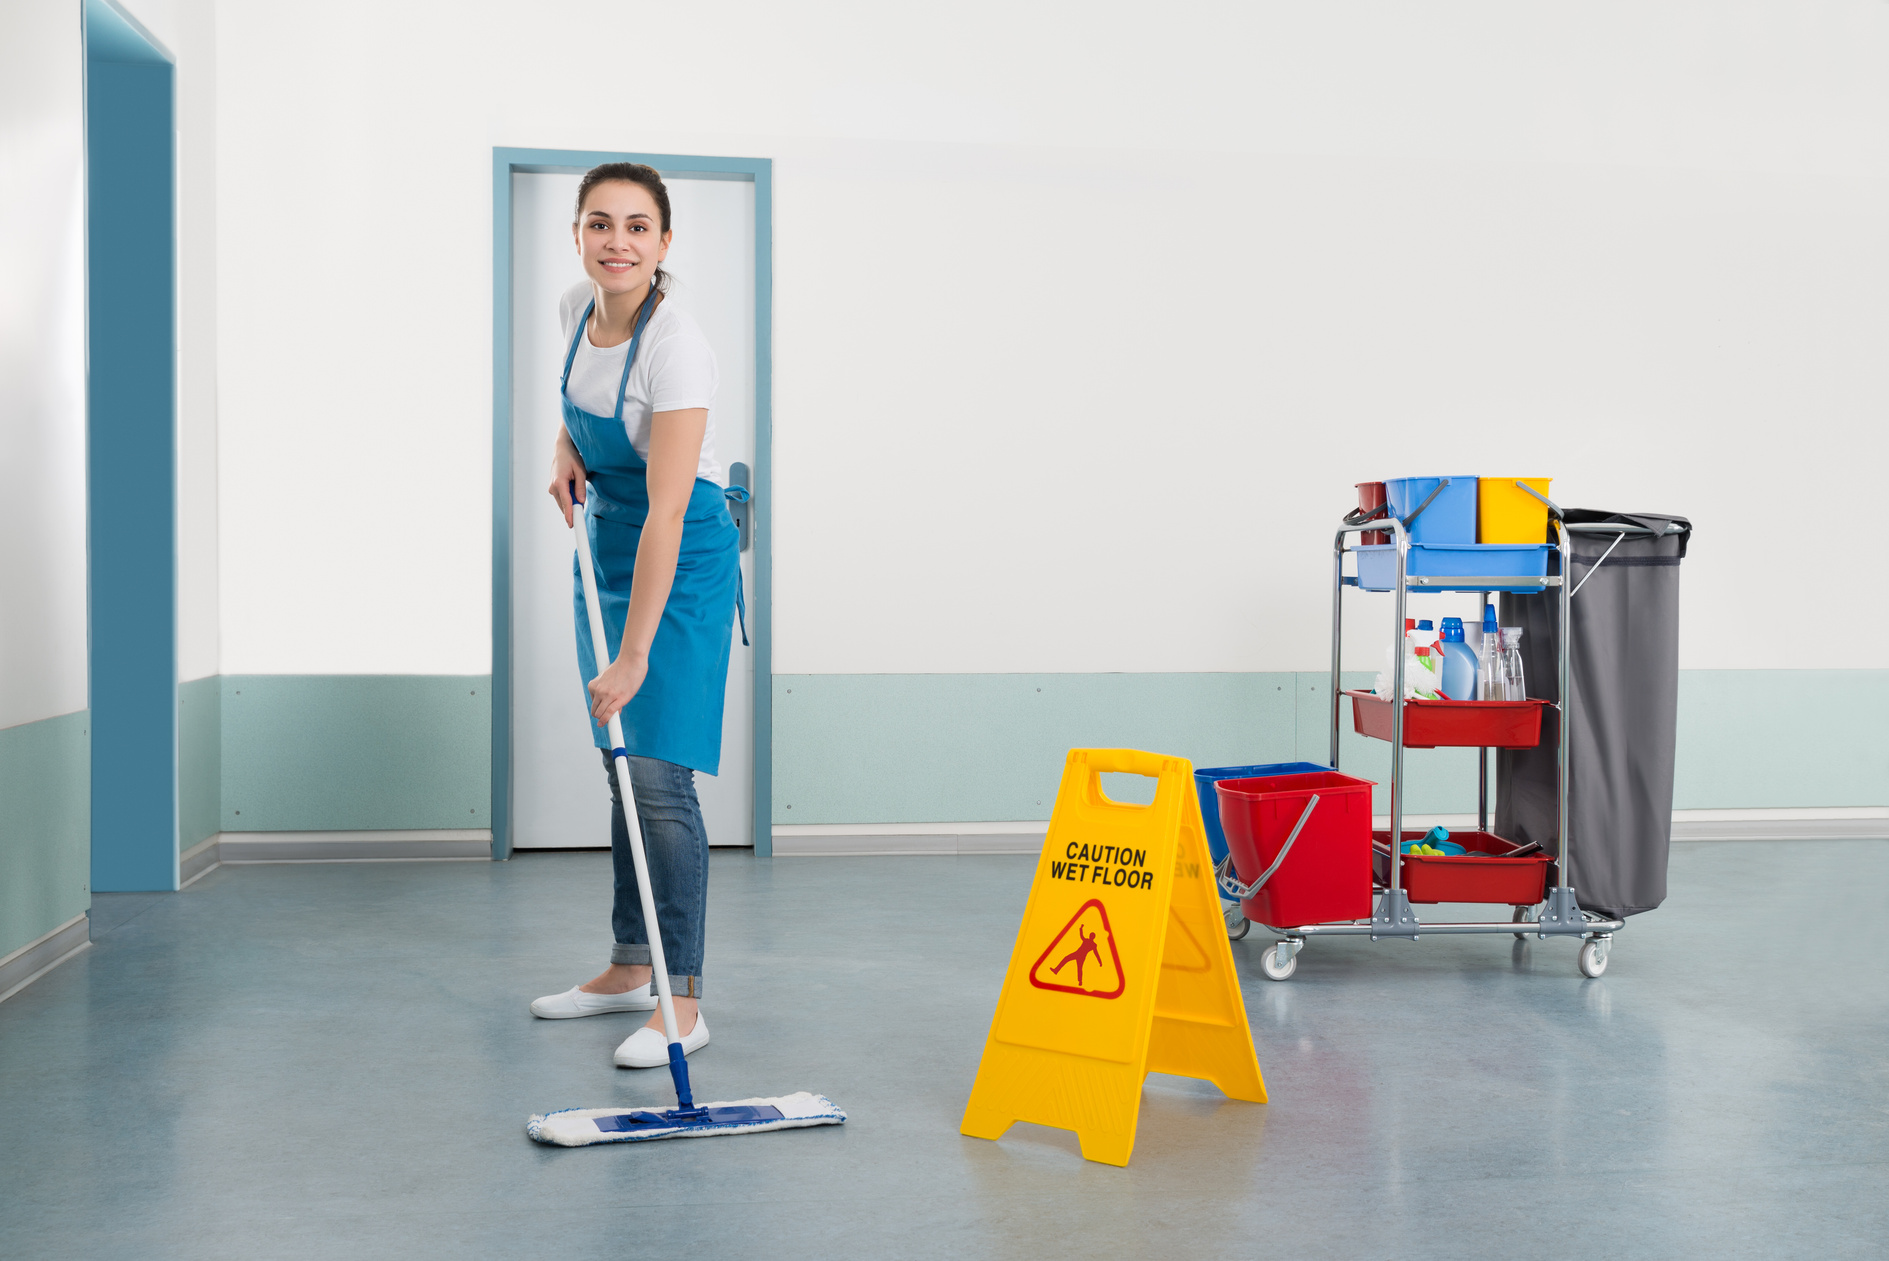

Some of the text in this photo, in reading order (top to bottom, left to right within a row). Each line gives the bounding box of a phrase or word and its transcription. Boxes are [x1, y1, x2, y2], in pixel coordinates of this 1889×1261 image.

[1066, 841, 1147, 868] CAUTION
[1051, 860, 1154, 890] WET FLOOR
